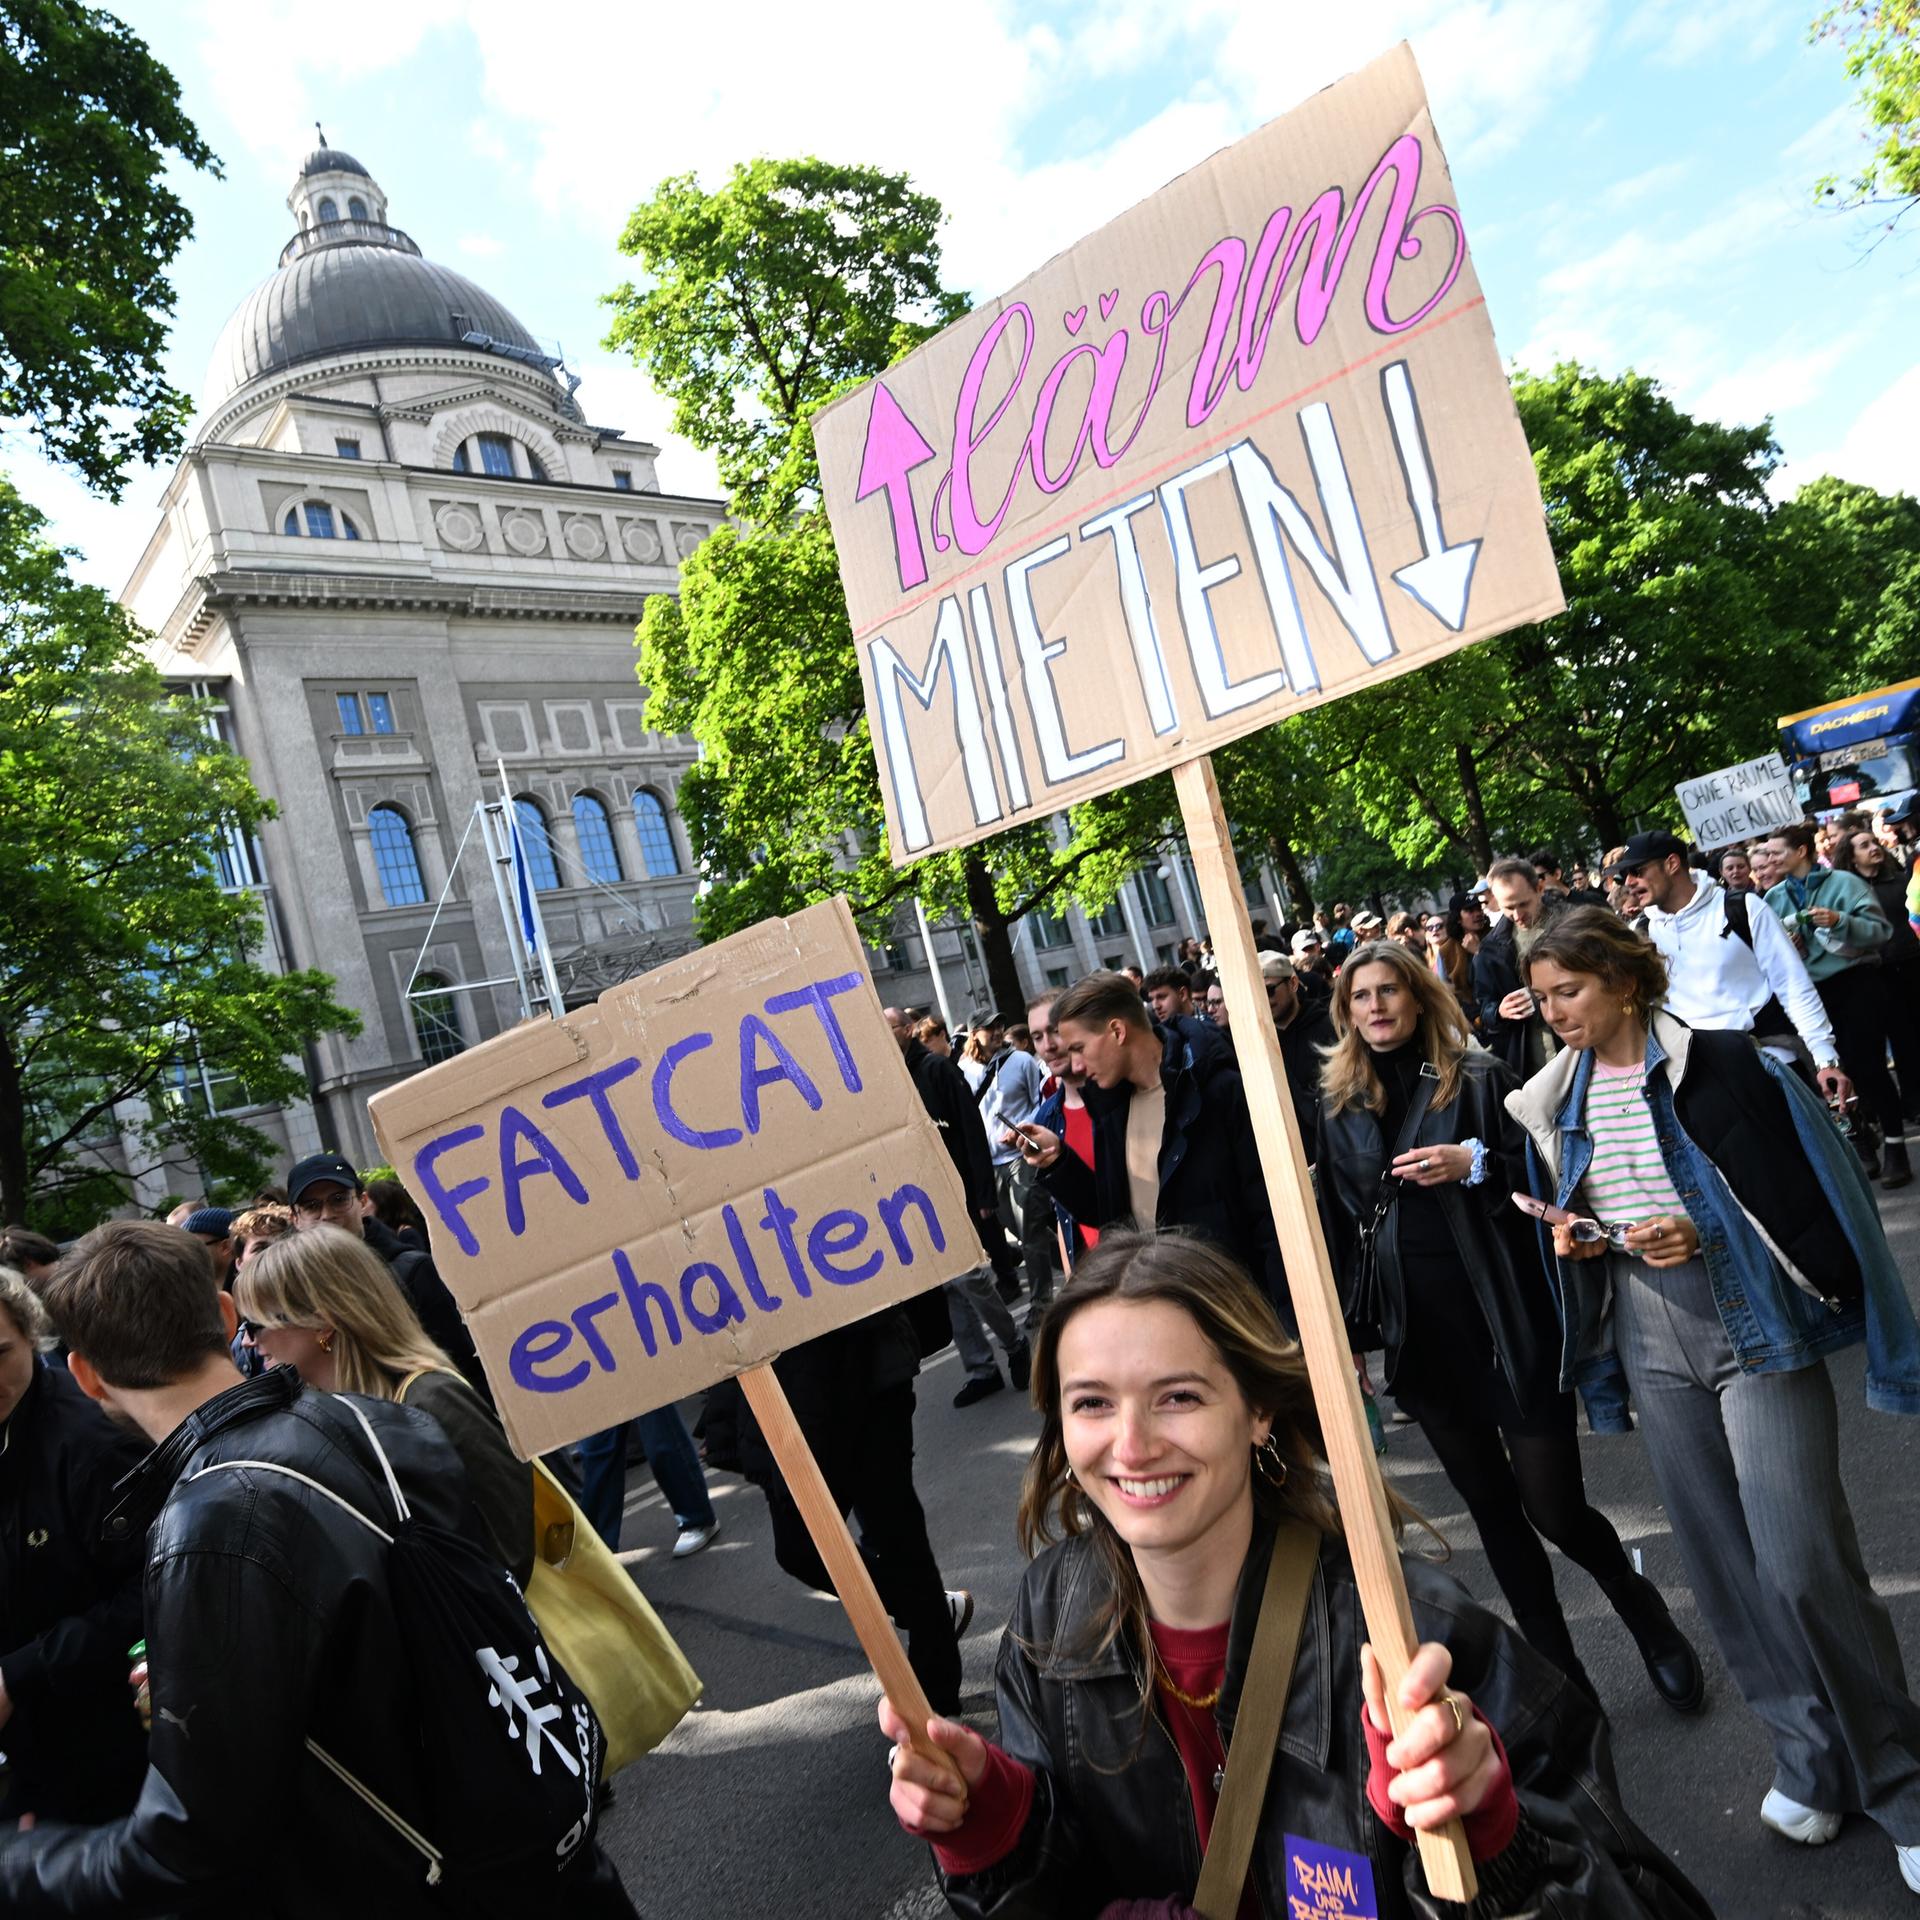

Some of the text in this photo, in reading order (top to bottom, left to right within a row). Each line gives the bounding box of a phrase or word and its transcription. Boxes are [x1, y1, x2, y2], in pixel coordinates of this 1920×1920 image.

[1682, 777, 1724, 811] OHNE
[1695, 807, 1746, 846] KEINE
[1746, 783, 1803, 829] KULTUR
[414, 971, 865, 1257] FATCAT
[508, 1183, 946, 1394] erhalten
[1314, 1893, 1345, 1912] UND
